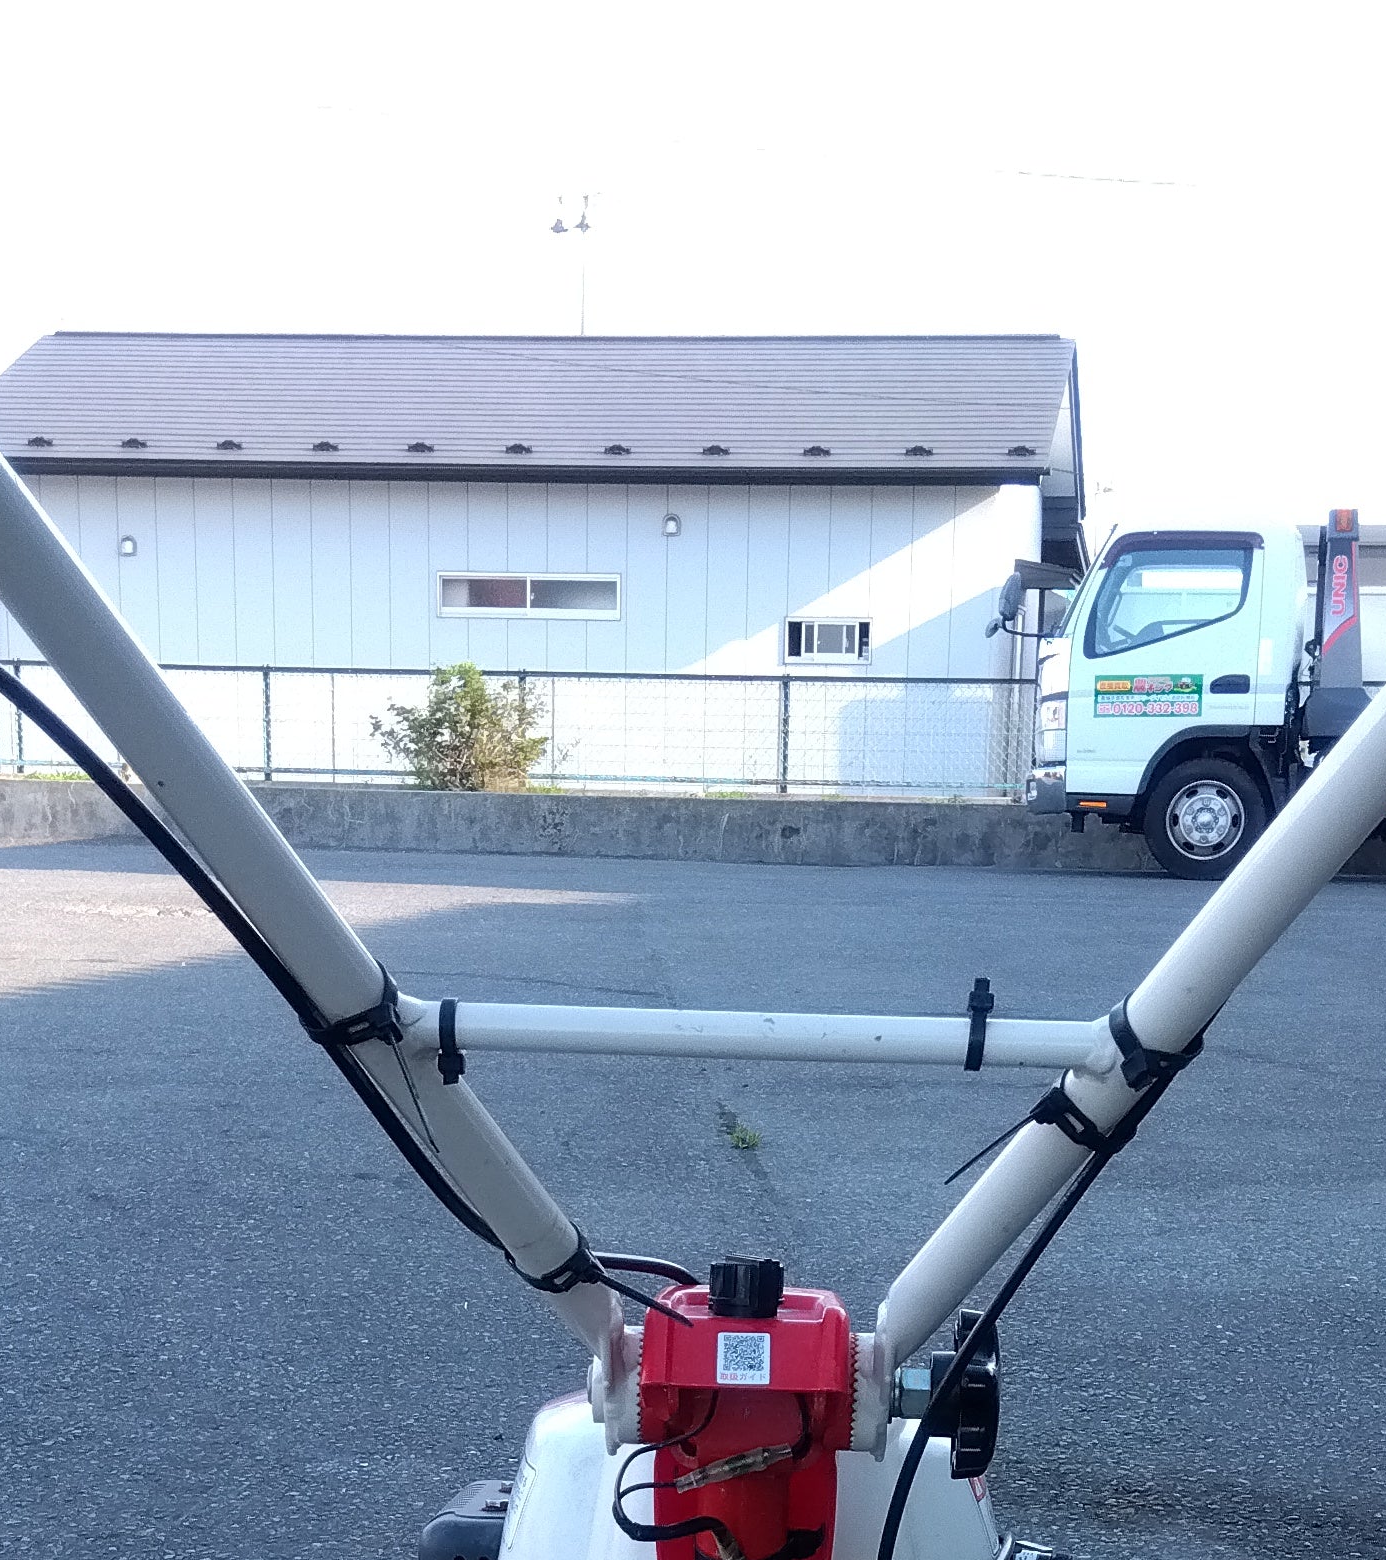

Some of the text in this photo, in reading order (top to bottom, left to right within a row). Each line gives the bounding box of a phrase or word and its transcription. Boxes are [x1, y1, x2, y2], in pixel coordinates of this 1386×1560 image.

[1331, 555, 1348, 617] UNIC
[1113, 702, 1198, 714] 0120-332-398
[720, 1372, 766, 1381] 取扱ガイド
